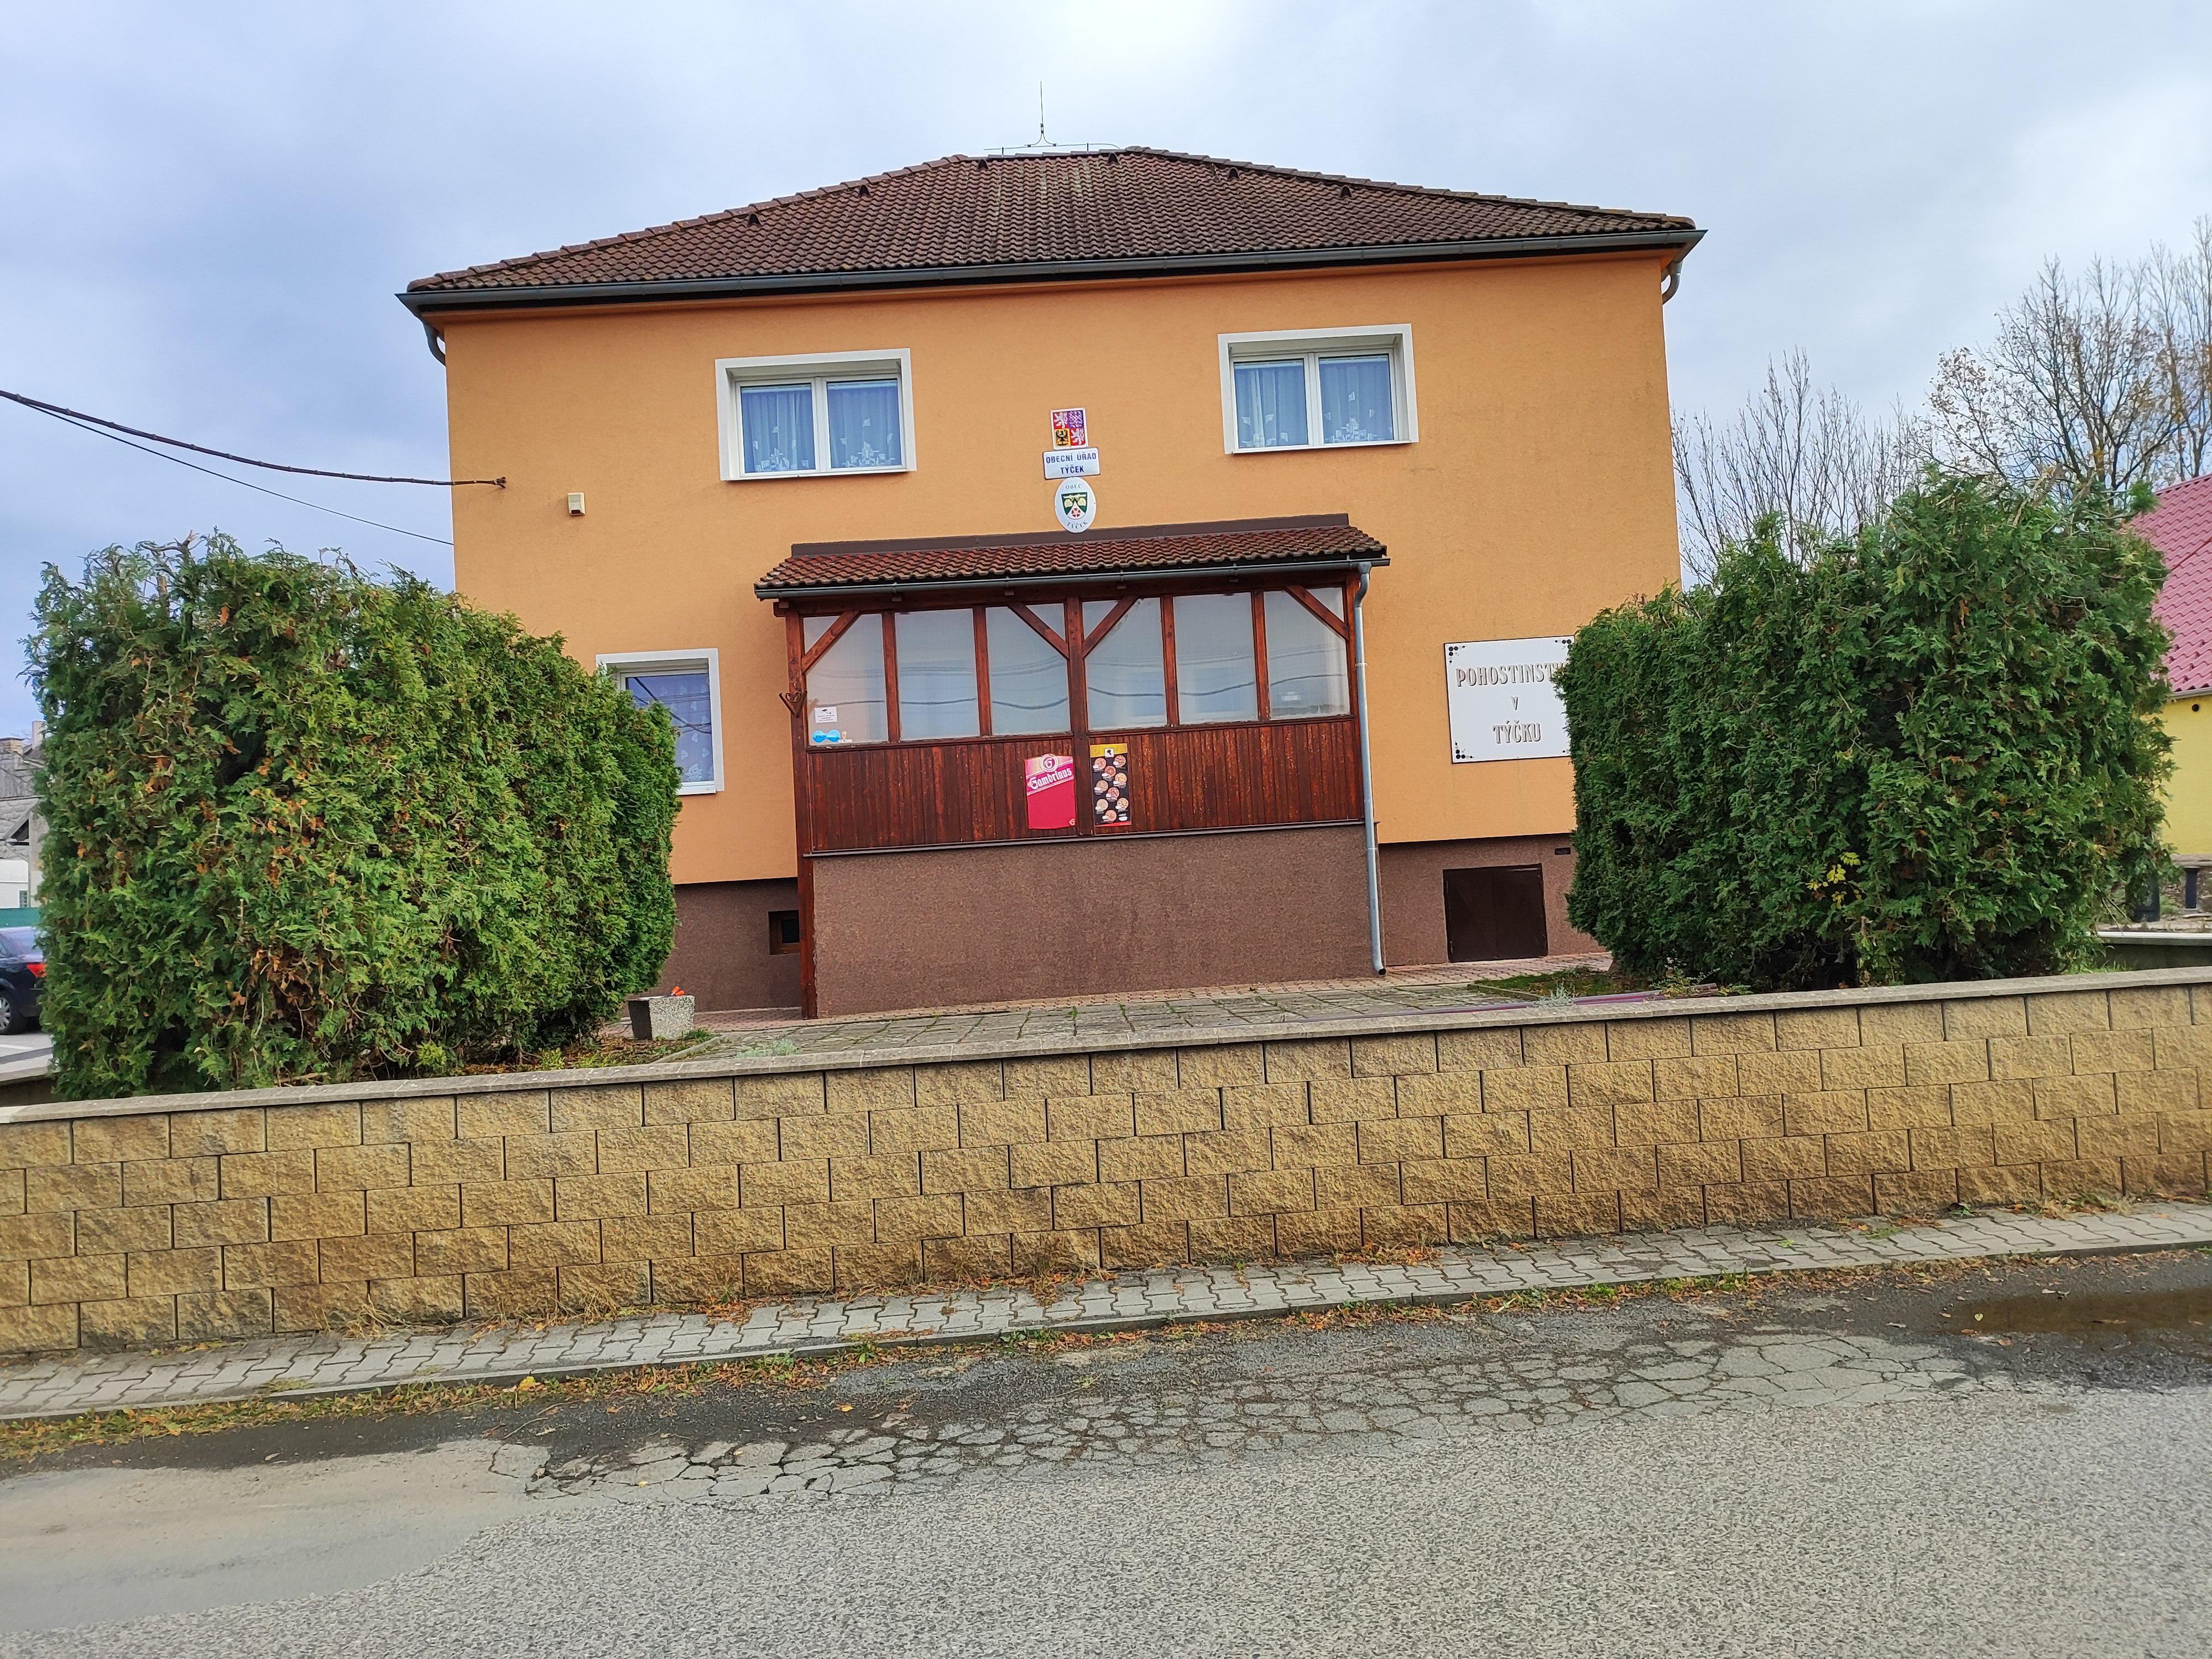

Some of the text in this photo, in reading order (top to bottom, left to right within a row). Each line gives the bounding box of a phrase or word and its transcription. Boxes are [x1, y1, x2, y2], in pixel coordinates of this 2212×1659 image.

[1046, 451, 1097, 464] OBECNÍ ÚŘAD
[1060, 464, 1084, 474] TÝČEK
[1455, 662, 1567, 687] POHOSTINST
[1493, 719, 1541, 744] TÝČKU
[1029, 767, 1073, 790] Gambrinus
